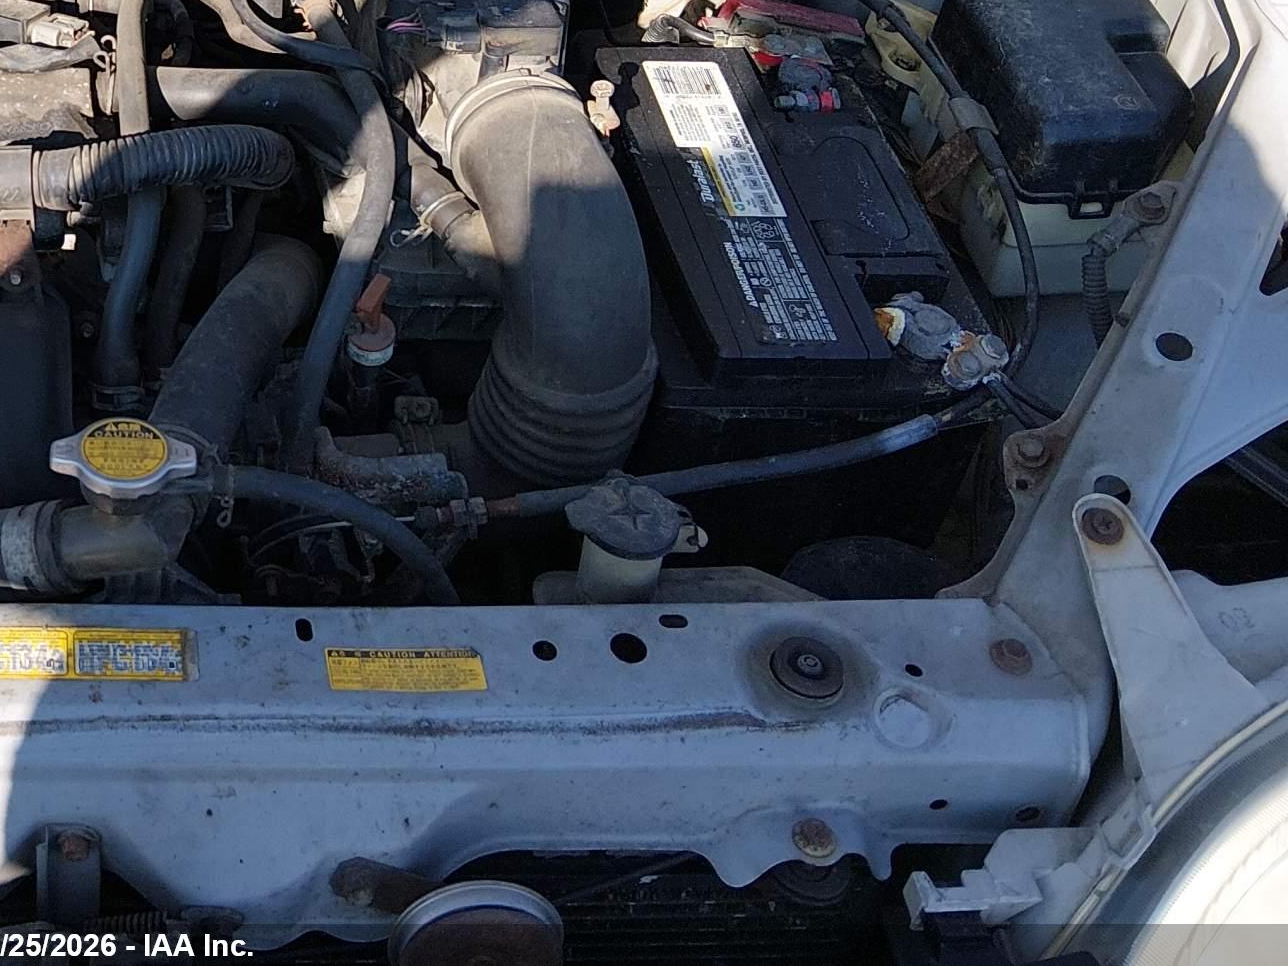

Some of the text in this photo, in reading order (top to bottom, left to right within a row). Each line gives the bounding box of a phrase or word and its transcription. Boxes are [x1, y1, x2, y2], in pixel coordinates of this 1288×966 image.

[687, 160, 715, 203] Duralast
[94, 430, 154, 440] CAUTION
[369, 650, 416, 659] CAUTION
